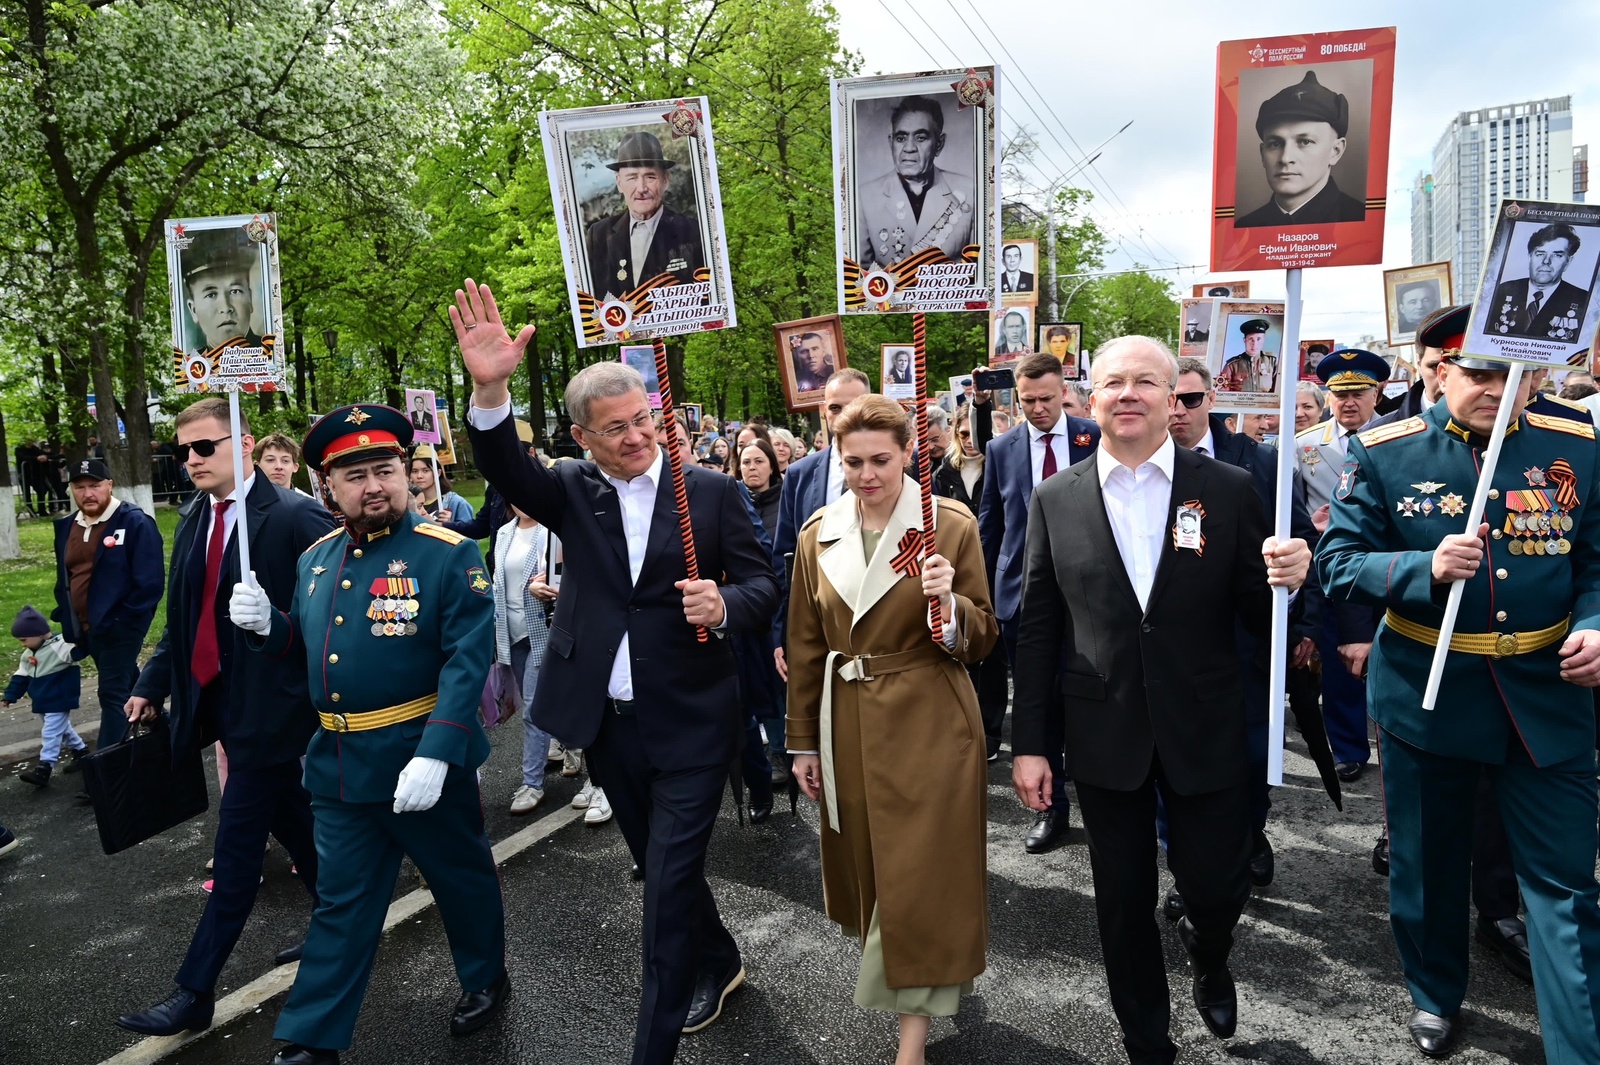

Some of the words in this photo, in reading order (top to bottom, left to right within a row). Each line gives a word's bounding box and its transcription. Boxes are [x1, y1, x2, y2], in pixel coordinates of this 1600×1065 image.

[1268, 45, 1307, 56] БЕССМЕРТНЫЙ
[1320, 44, 1332, 55] 80
[1333, 42, 1366, 53] ПОБЕДА!
[1283, 53, 1304, 61] РОССИИ
[1527, 209, 1579, 218] БЕССМЕРТНЫЙ
[1277, 233, 1319, 243] Назаров
[1259, 245, 1287, 255] Ефим
[1290, 243, 1337, 252] Иванович
[1265, 252, 1299, 260] младший
[1300, 251, 1331, 259] сержант
[917, 264, 975, 276] БАБОЯН
[917, 277, 969, 288] ИОСИФ
[648, 283, 711, 300] ХАБИРОВ
[902, 289, 986, 301] РУБЕНОВИЧ
[653, 295, 701, 312] БАРЫЙ
[917, 302, 964, 311] СЕРЖАНТ
[636, 305, 723, 326] ЛАТЫПОВИЧ
[656, 321, 701, 335] РЯДОВОЙ
[1490, 337, 1529, 347] Курносов
[1530, 342, 1567, 351] Николай
[224, 347, 262, 357] Бадранов
[1500, 346, 1552, 357] Михайлович
[220, 356, 268, 364] Шайхислам
[220, 365, 268, 374] Магадеевич
